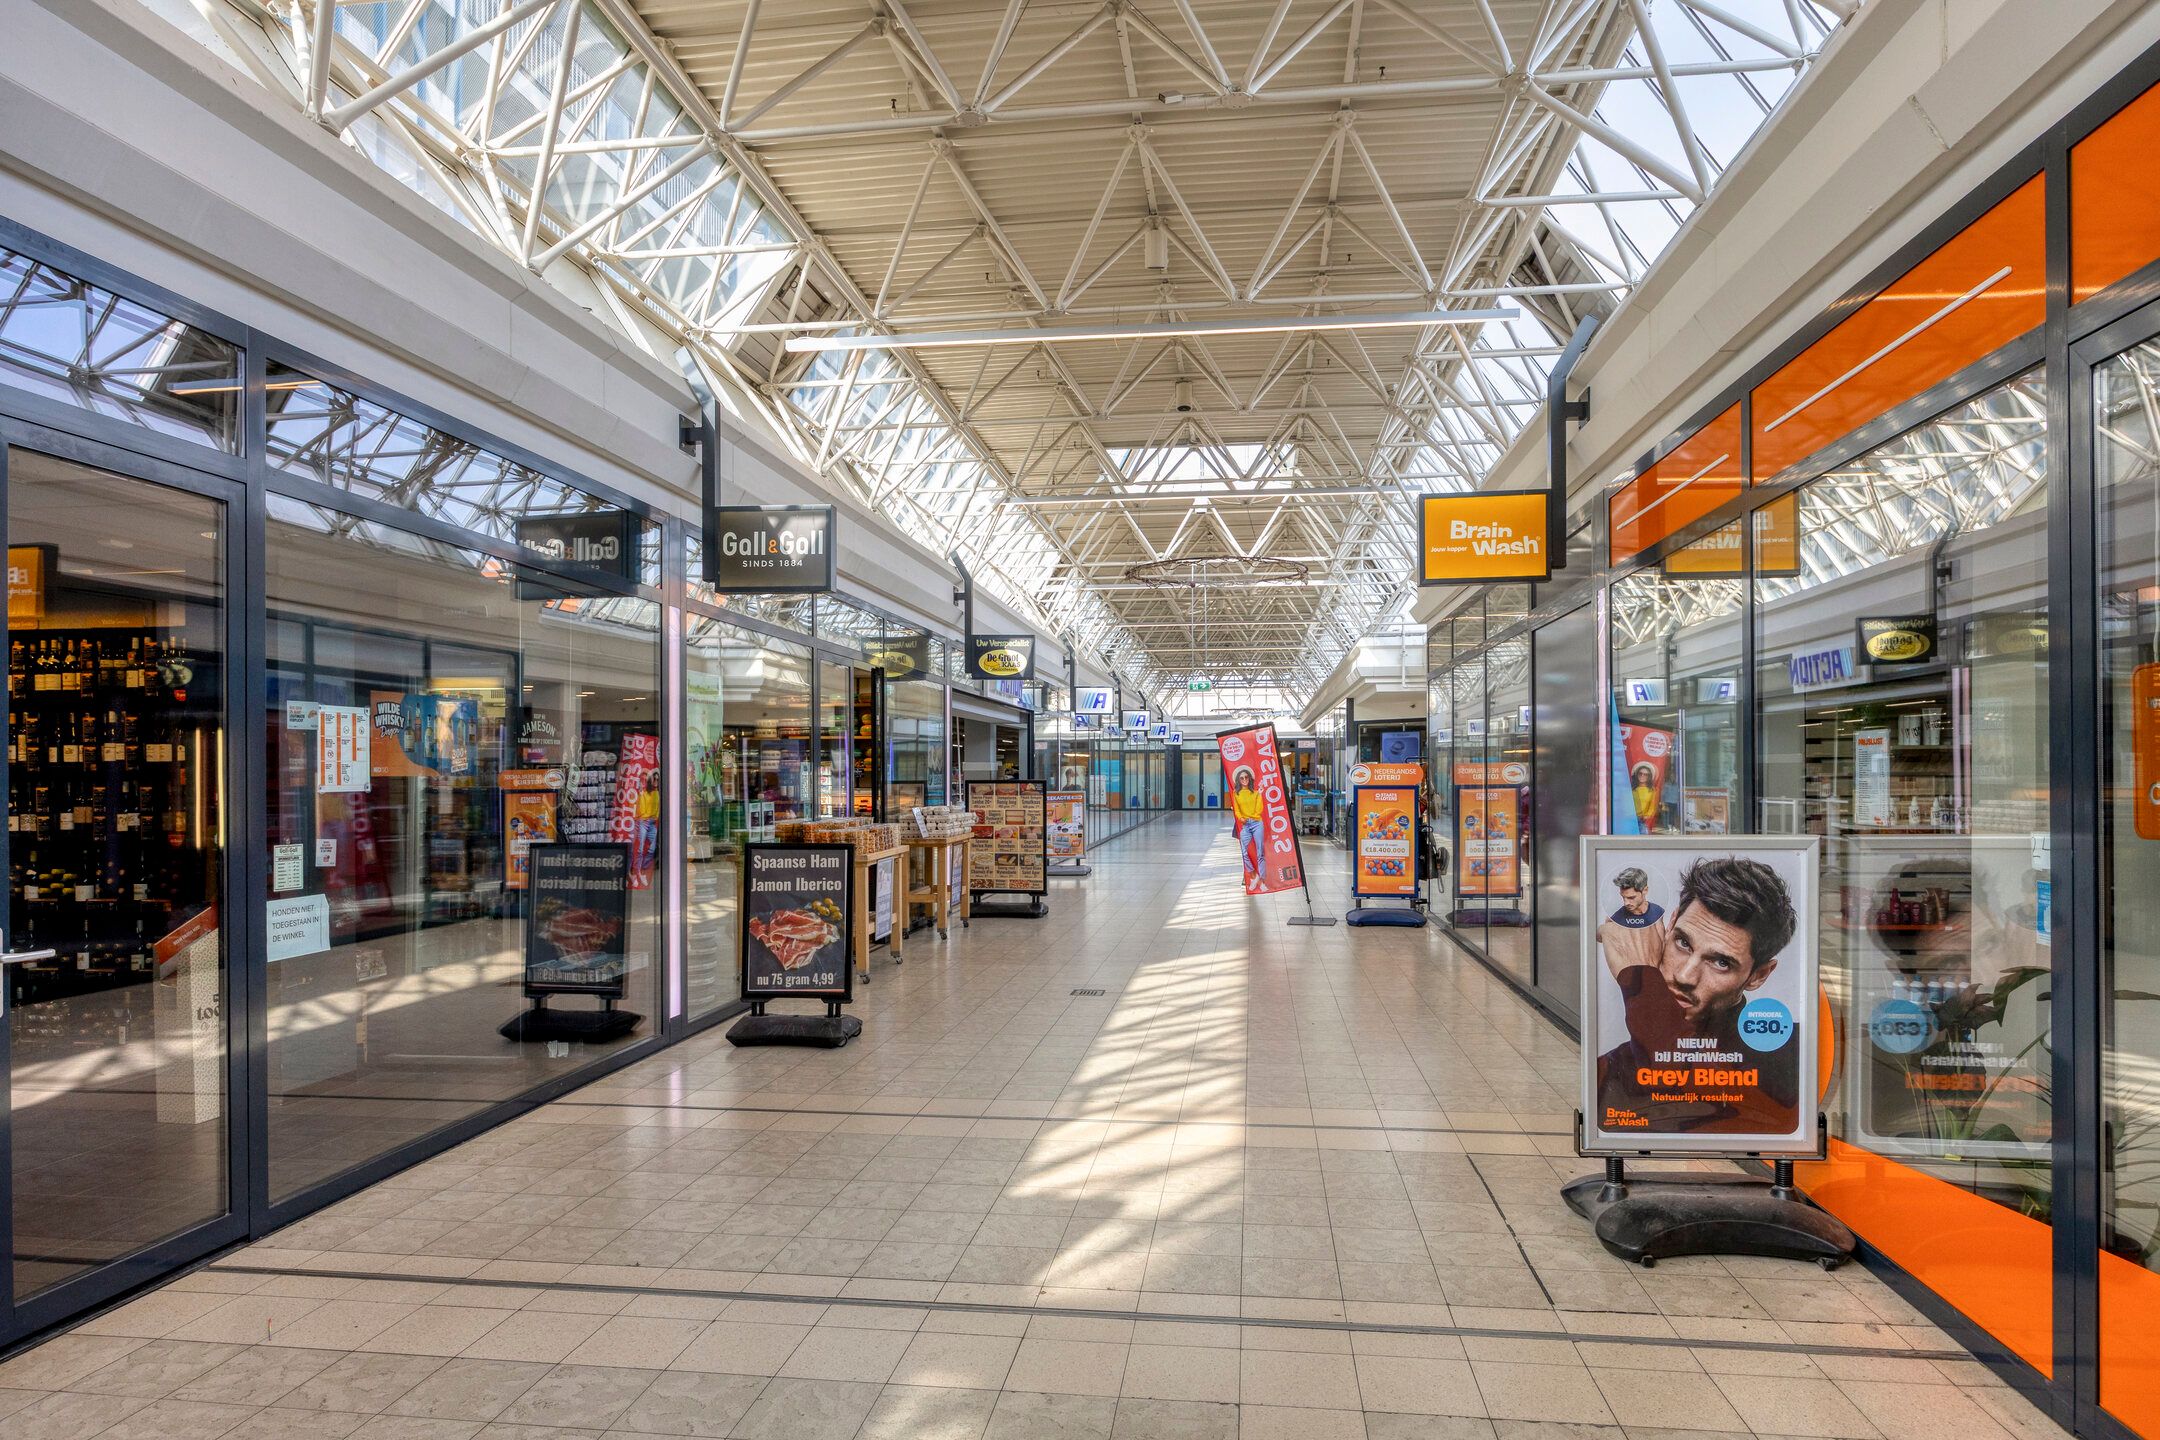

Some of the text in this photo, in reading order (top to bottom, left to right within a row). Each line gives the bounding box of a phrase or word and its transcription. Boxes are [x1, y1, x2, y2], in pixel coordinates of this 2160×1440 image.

[1450, 519, 1512, 539] Brain
[742, 560, 803, 568] SINDS 1884
[976, 639, 988, 647] Uw
[377, 702, 400, 714] WILDE
[375, 713, 405, 728] WHISKY
[521, 721, 556, 737] JAMESON
[753, 855, 840, 871] Spaanse Ham
[751, 877, 842, 892] Jamon Iberico
[271, 904, 315, 917] HONDEN NIET
[272, 916, 320, 931] TOEGESTAAN IN
[272, 931, 306, 943] DE WINKEL
[757, 976, 769, 986] nu
[771, 973, 783, 986] 75
[785, 975, 810, 988] gram
[1743, 1019, 1789, 1035] €30,-
[1677, 1038, 1718, 1049] NIEUW
[1655, 1051, 1743, 1063] bij BrainWash
[1636, 1067, 1758, 1091] Grey Blend
[1652, 1092, 1744, 1102] Natuurlijk resultaat
[1607, 1108, 1636, 1118] Brain
[1618, 1117, 1648, 1126] Wash
